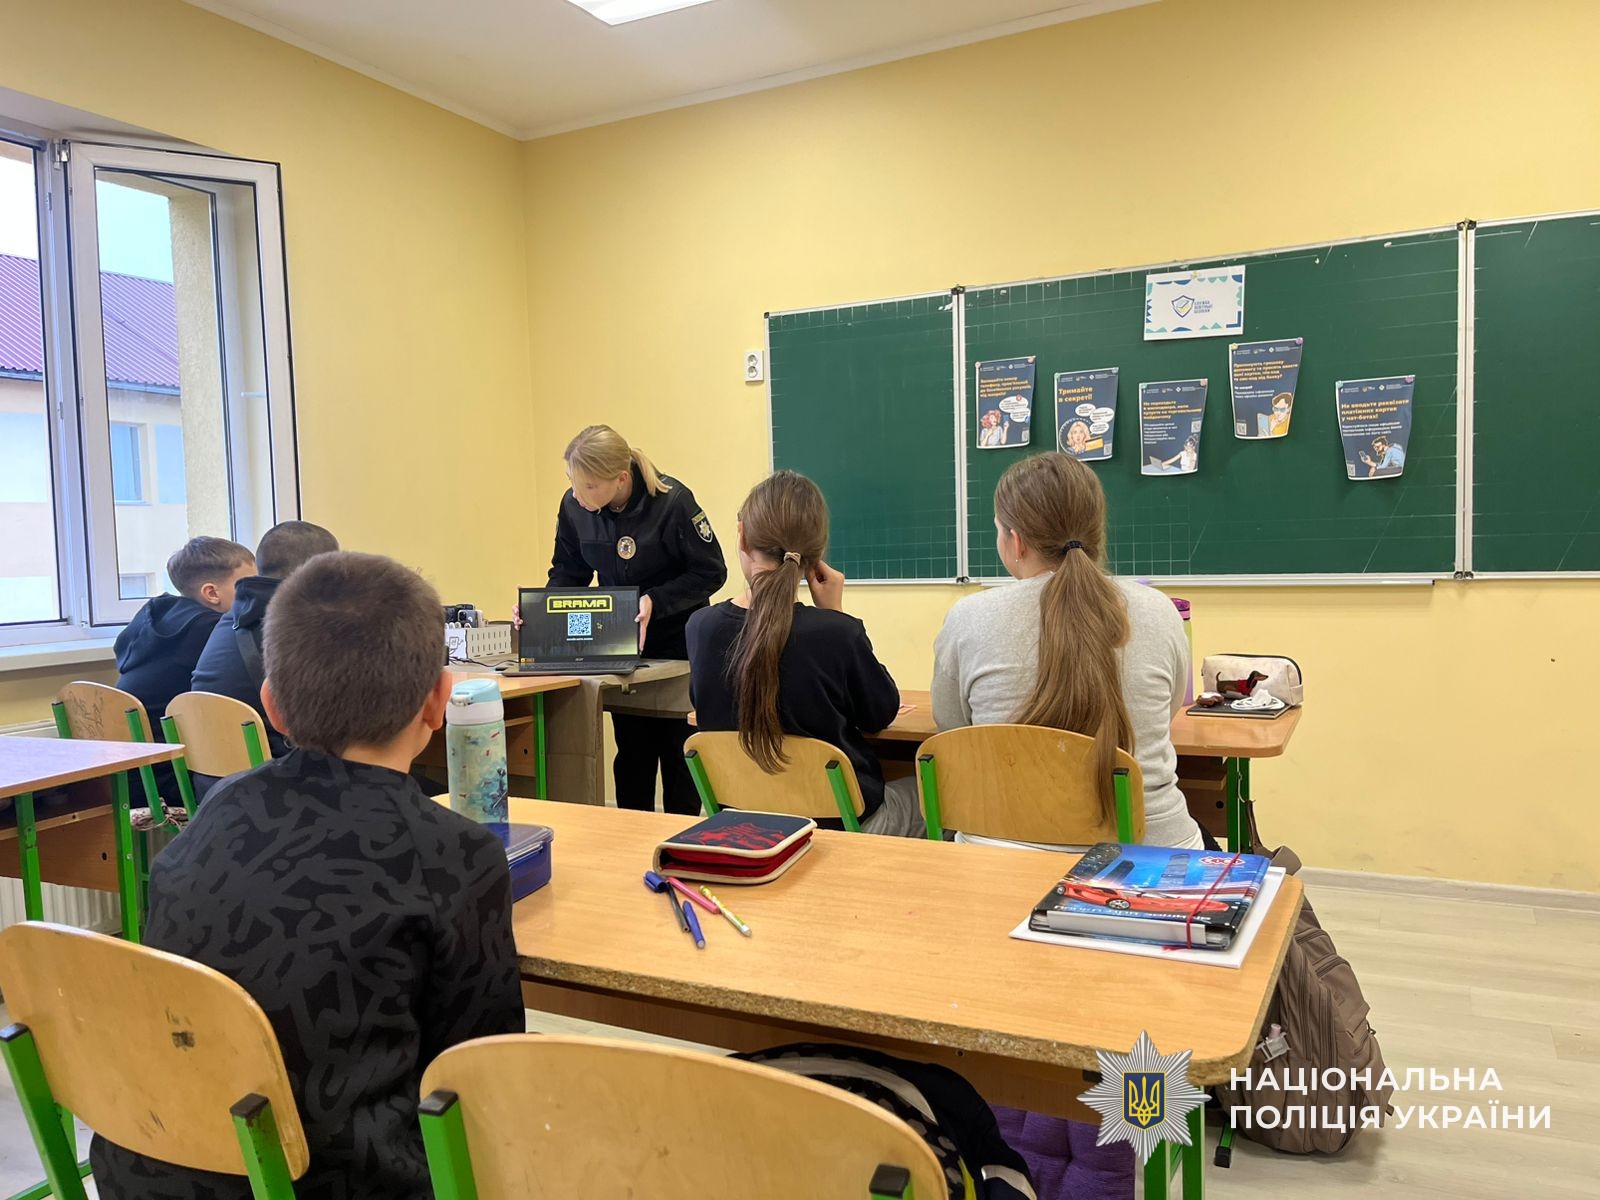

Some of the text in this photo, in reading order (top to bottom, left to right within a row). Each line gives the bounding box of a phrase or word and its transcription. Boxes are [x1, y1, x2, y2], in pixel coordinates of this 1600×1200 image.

[1058, 386, 1093, 396] Тримайте
[1064, 393, 1093, 402] секреті!
[1378, 399, 1409, 407] реквізити
[553, 599, 607, 609] BRAMA
